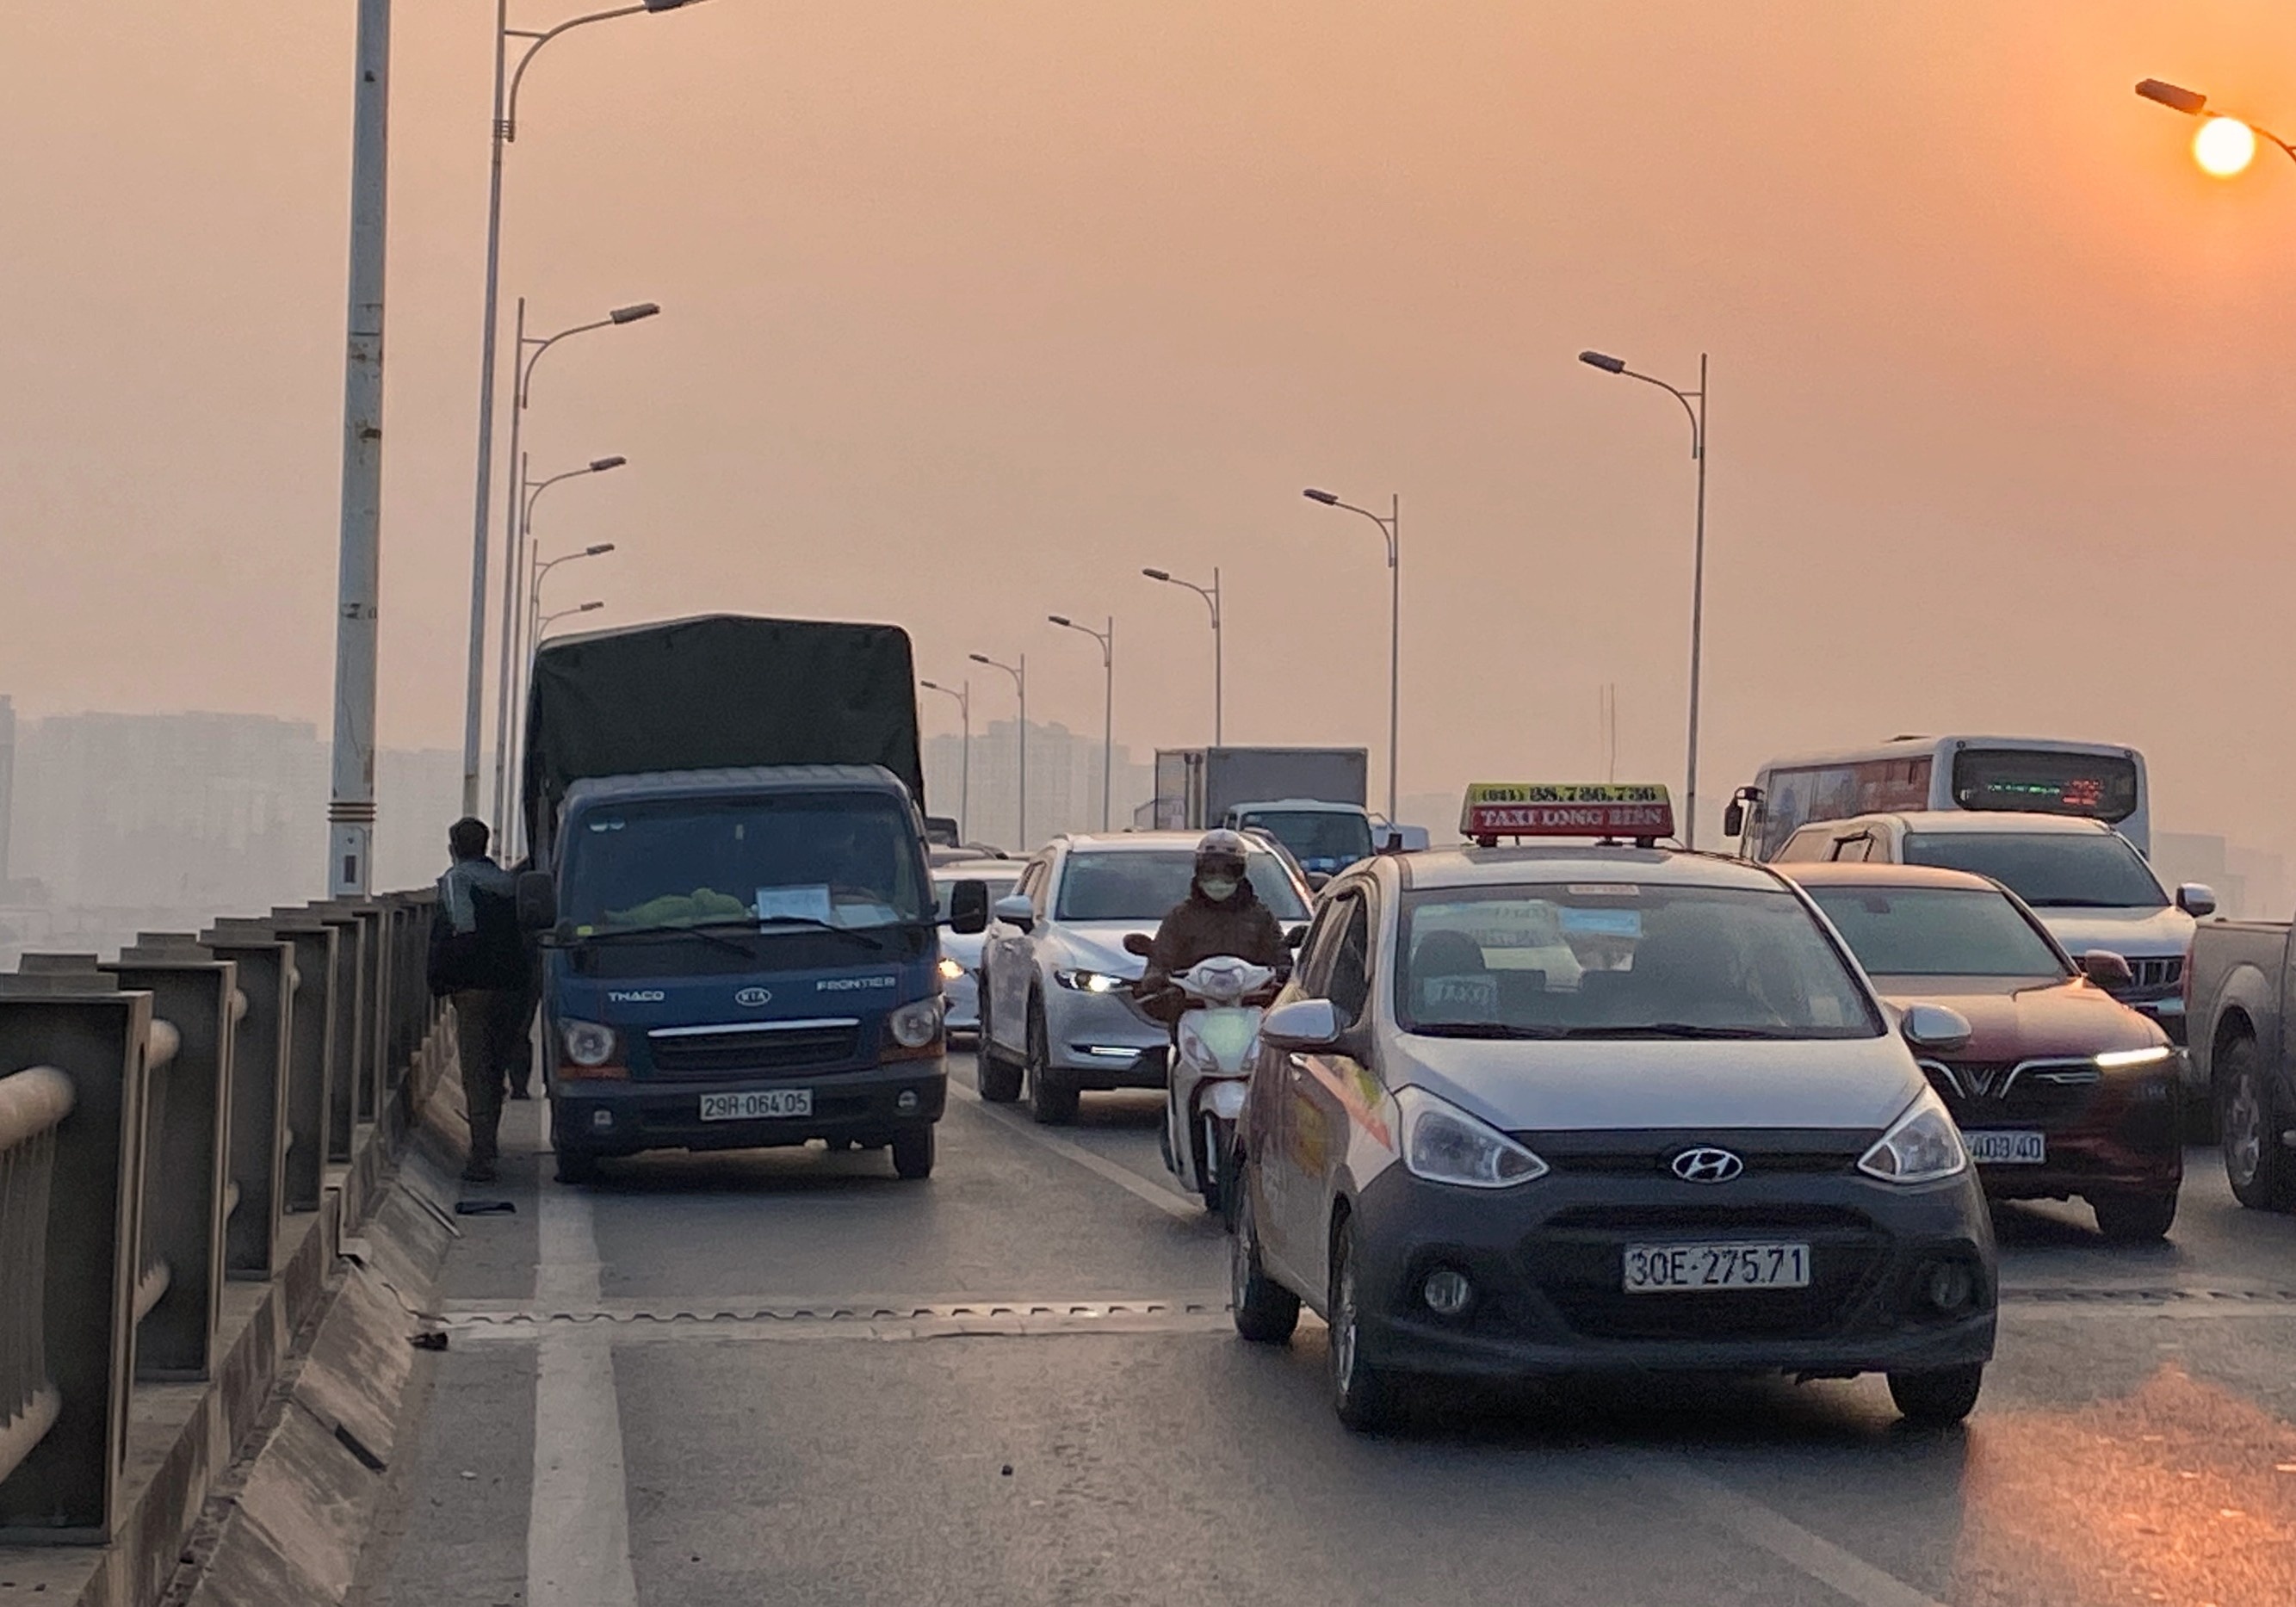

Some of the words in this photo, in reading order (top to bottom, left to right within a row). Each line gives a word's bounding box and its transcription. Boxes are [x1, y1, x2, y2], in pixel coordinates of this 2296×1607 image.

[1481, 809, 1535, 826] TAXI
[1541, 809, 1604, 825] LONG
[816, 976, 895, 991] FRONTIER
[608, 991, 664, 1002] THACO
